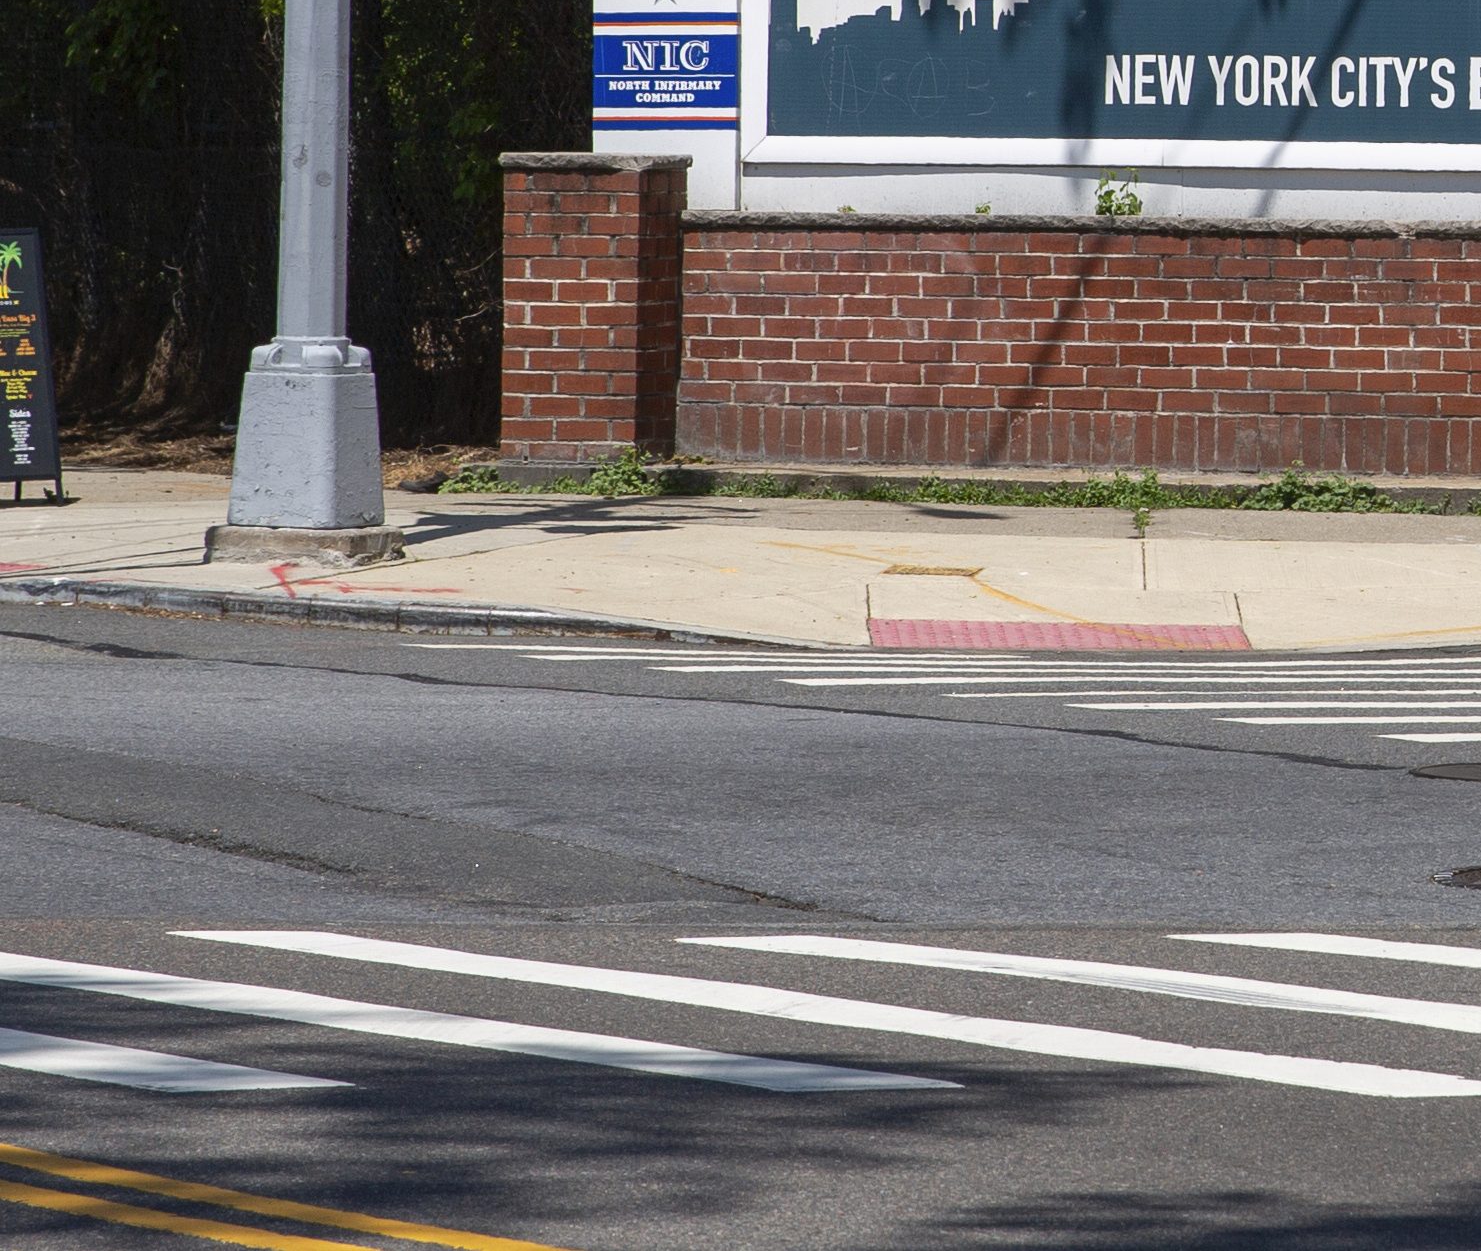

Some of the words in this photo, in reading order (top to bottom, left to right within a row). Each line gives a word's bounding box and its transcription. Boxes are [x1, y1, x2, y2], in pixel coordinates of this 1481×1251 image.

[622, 40, 710, 71] NIC
[609, 80, 650, 90] NORTH
[654, 80, 722, 90] INFIRMARY
[1104, 54, 1196, 105] NEW
[1207, 54, 1319, 107] YORK
[1330, 56, 1456, 110] CITY'S
[635, 93, 695, 103] COMMAND
